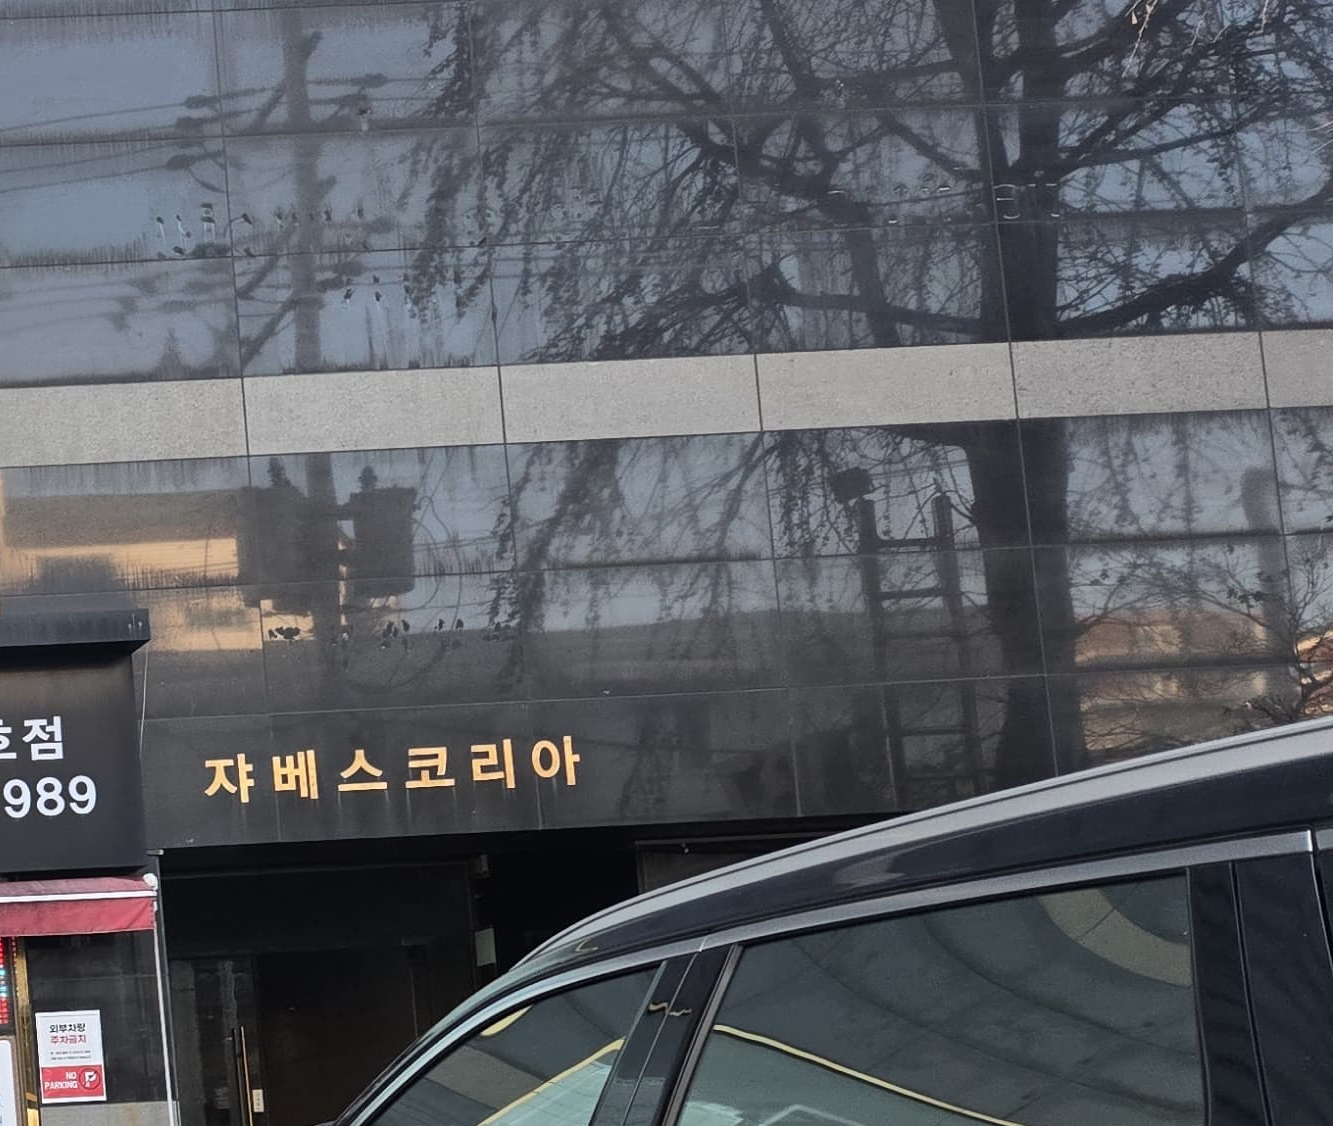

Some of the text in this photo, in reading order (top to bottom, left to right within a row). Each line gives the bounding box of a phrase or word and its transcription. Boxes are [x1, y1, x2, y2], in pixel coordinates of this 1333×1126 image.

[203, 735, 581, 804] 쟈베스코리아
[65, 1071, 77, 1080] NO
[44, 1080, 78, 1090] PARKING
